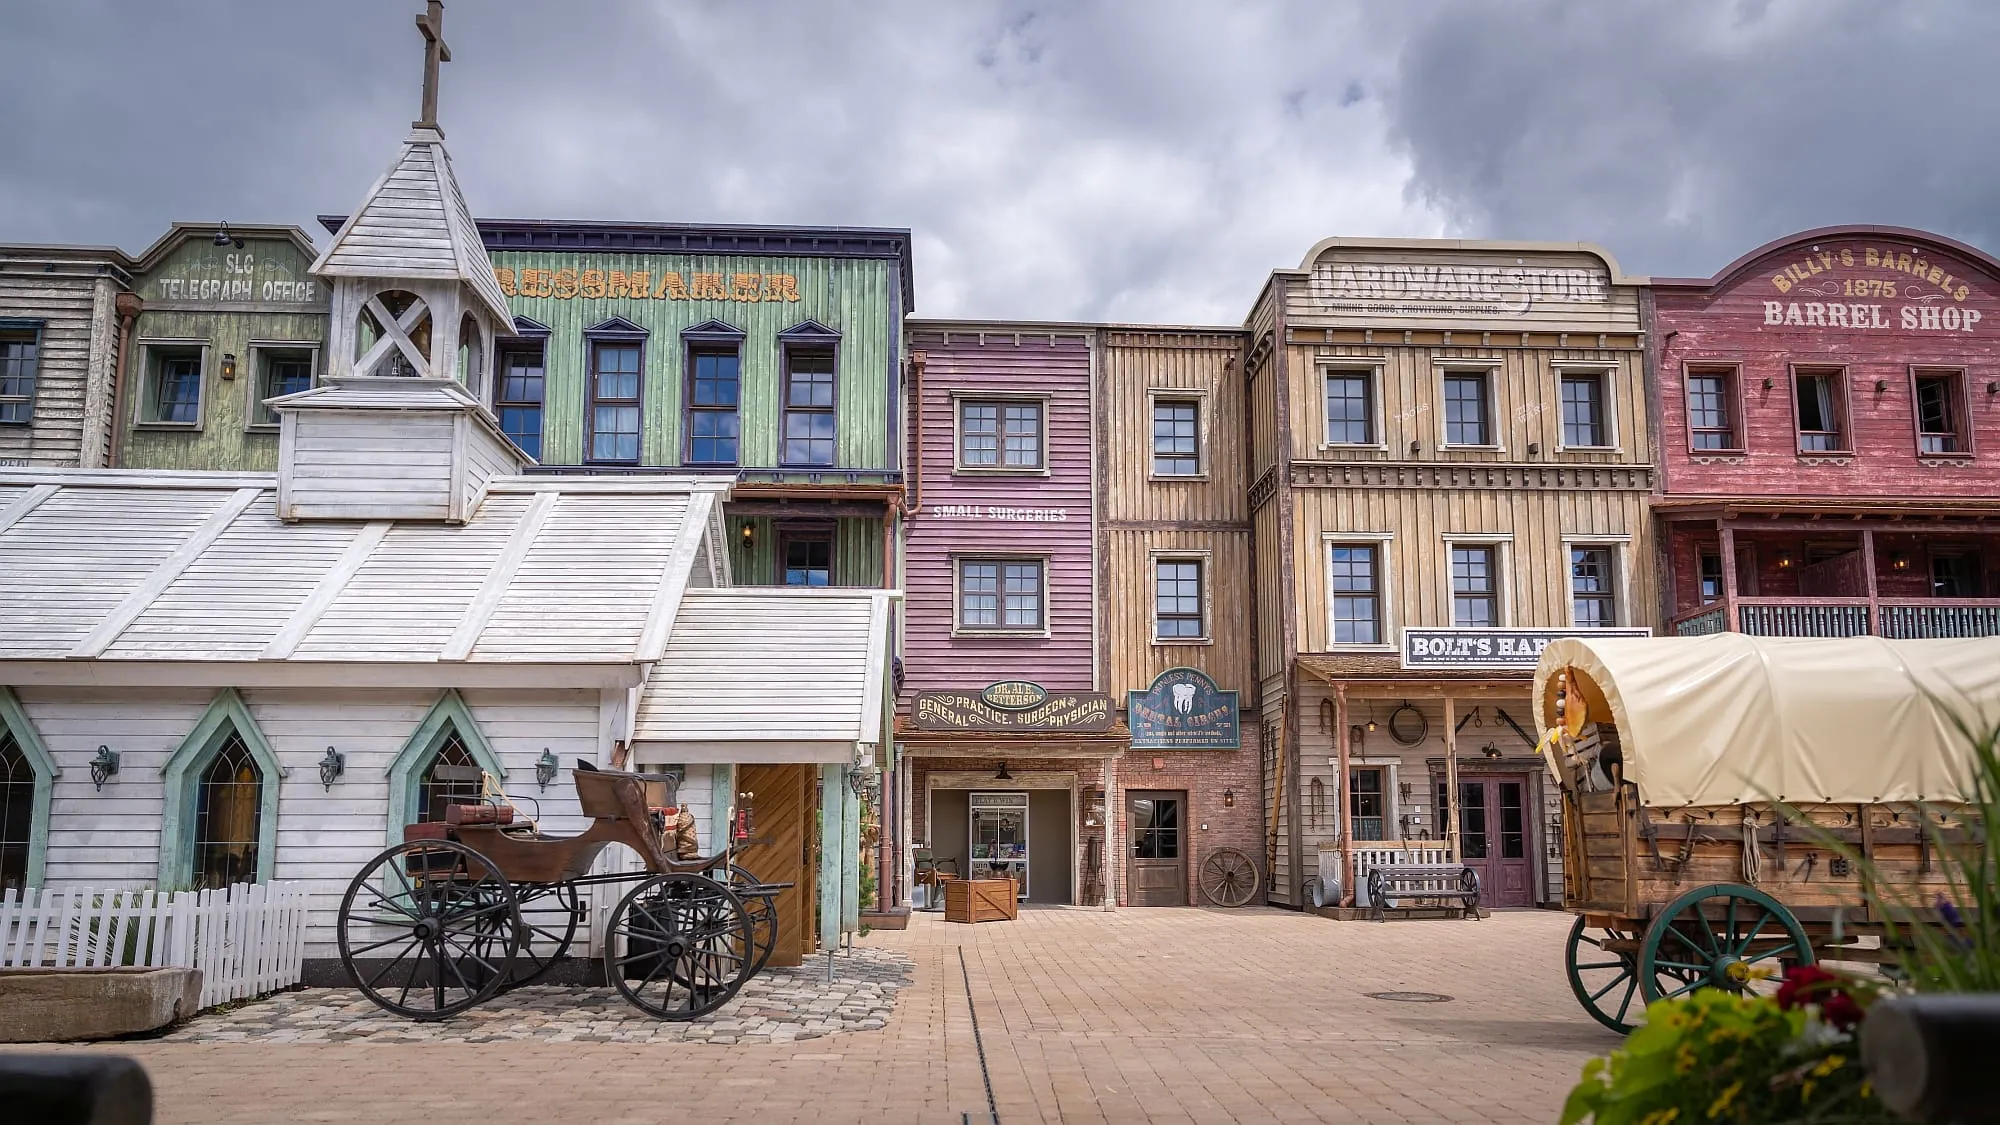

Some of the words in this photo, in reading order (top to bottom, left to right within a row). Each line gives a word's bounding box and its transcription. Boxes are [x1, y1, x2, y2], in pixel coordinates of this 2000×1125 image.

[1771, 248, 1854, 294] BILLY'S
[1865, 247, 1970, 302] BARRELS
[159, 278, 253, 301] TELEGRAPH
[262, 280, 317, 302] OFFICE
[1312, 263, 1502, 304] HARDWARE
[1499, 266, 1610, 316] STORE
[1843, 279, 1897, 298] 1875
[1332, 303, 1363, 313] MINING
[1763, 300, 1890, 329] BARREL
[1900, 305, 1982, 332] SHOP
[933, 505, 983, 518] SMALL
[987, 506, 1067, 521] SURGERIES
[1412, 637, 1492, 656] BOLT'S
[1152, 671, 1185, 696] PAINLESS
[919, 698, 969, 727] GENERAL
[1017, 696, 1067, 724] SURGEON
[1049, 699, 1107, 727] PHYSICIAN
[987, 694, 1042, 706] BETTERSON
[1135, 702, 1181, 727] DENTAL
[1186, 704, 1229, 727] CIRCUS
